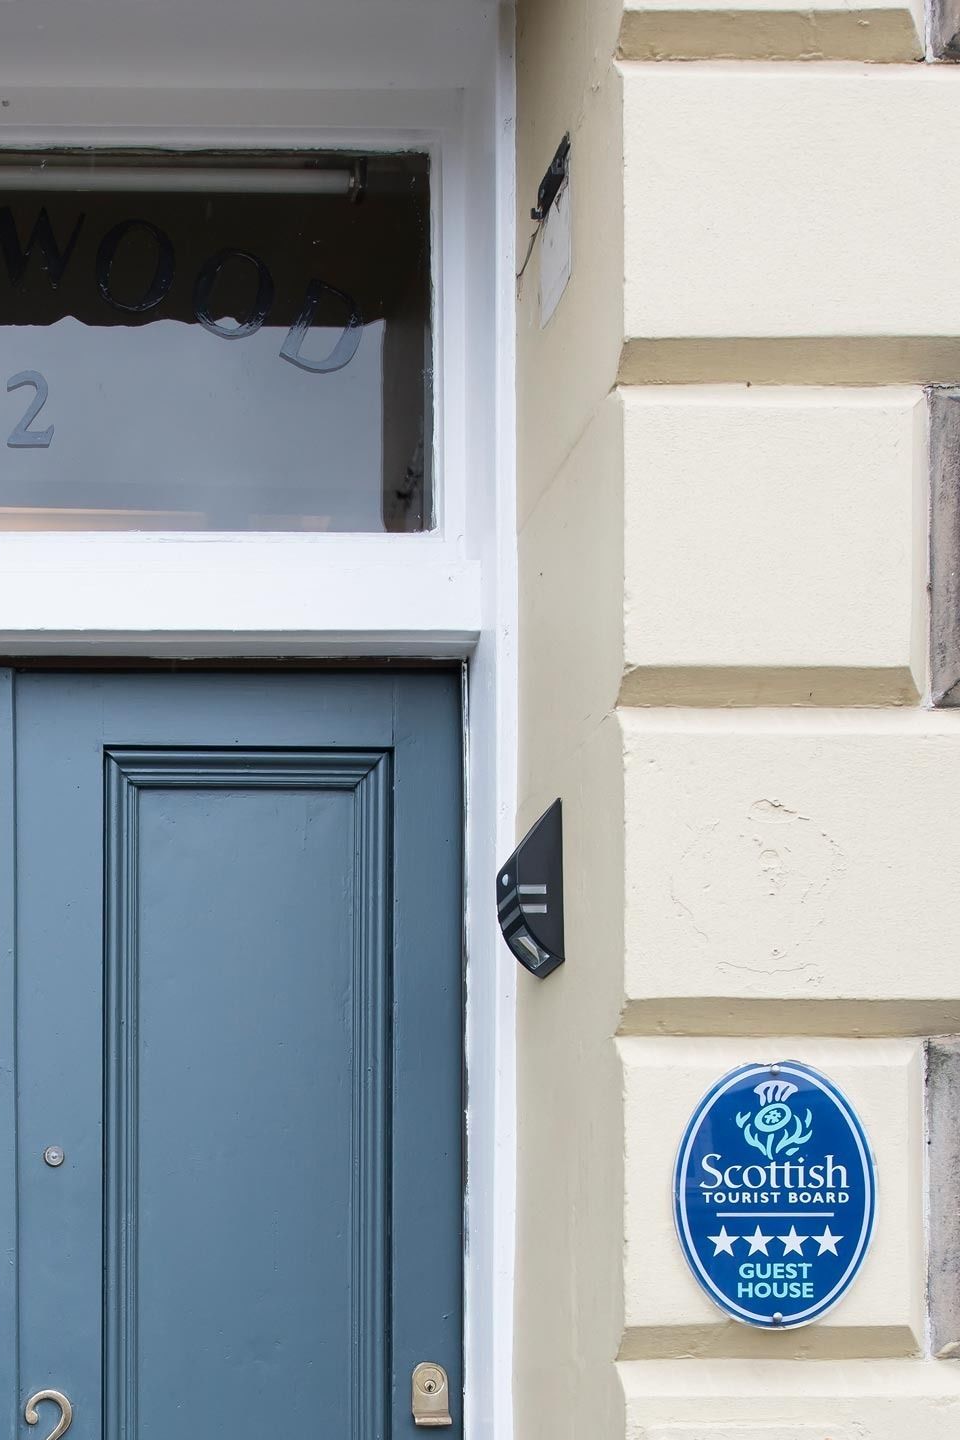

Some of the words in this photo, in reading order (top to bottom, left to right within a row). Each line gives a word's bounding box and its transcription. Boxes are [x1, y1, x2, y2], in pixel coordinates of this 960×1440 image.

[699, 1153, 850, 1189] Scottish
[702, 1191, 782, 1204] TOURIST
[788, 1191, 850, 1204] BOARD
[739, 1263, 812, 1279] GUEST
[737, 1282, 814, 1298] HOUSE
